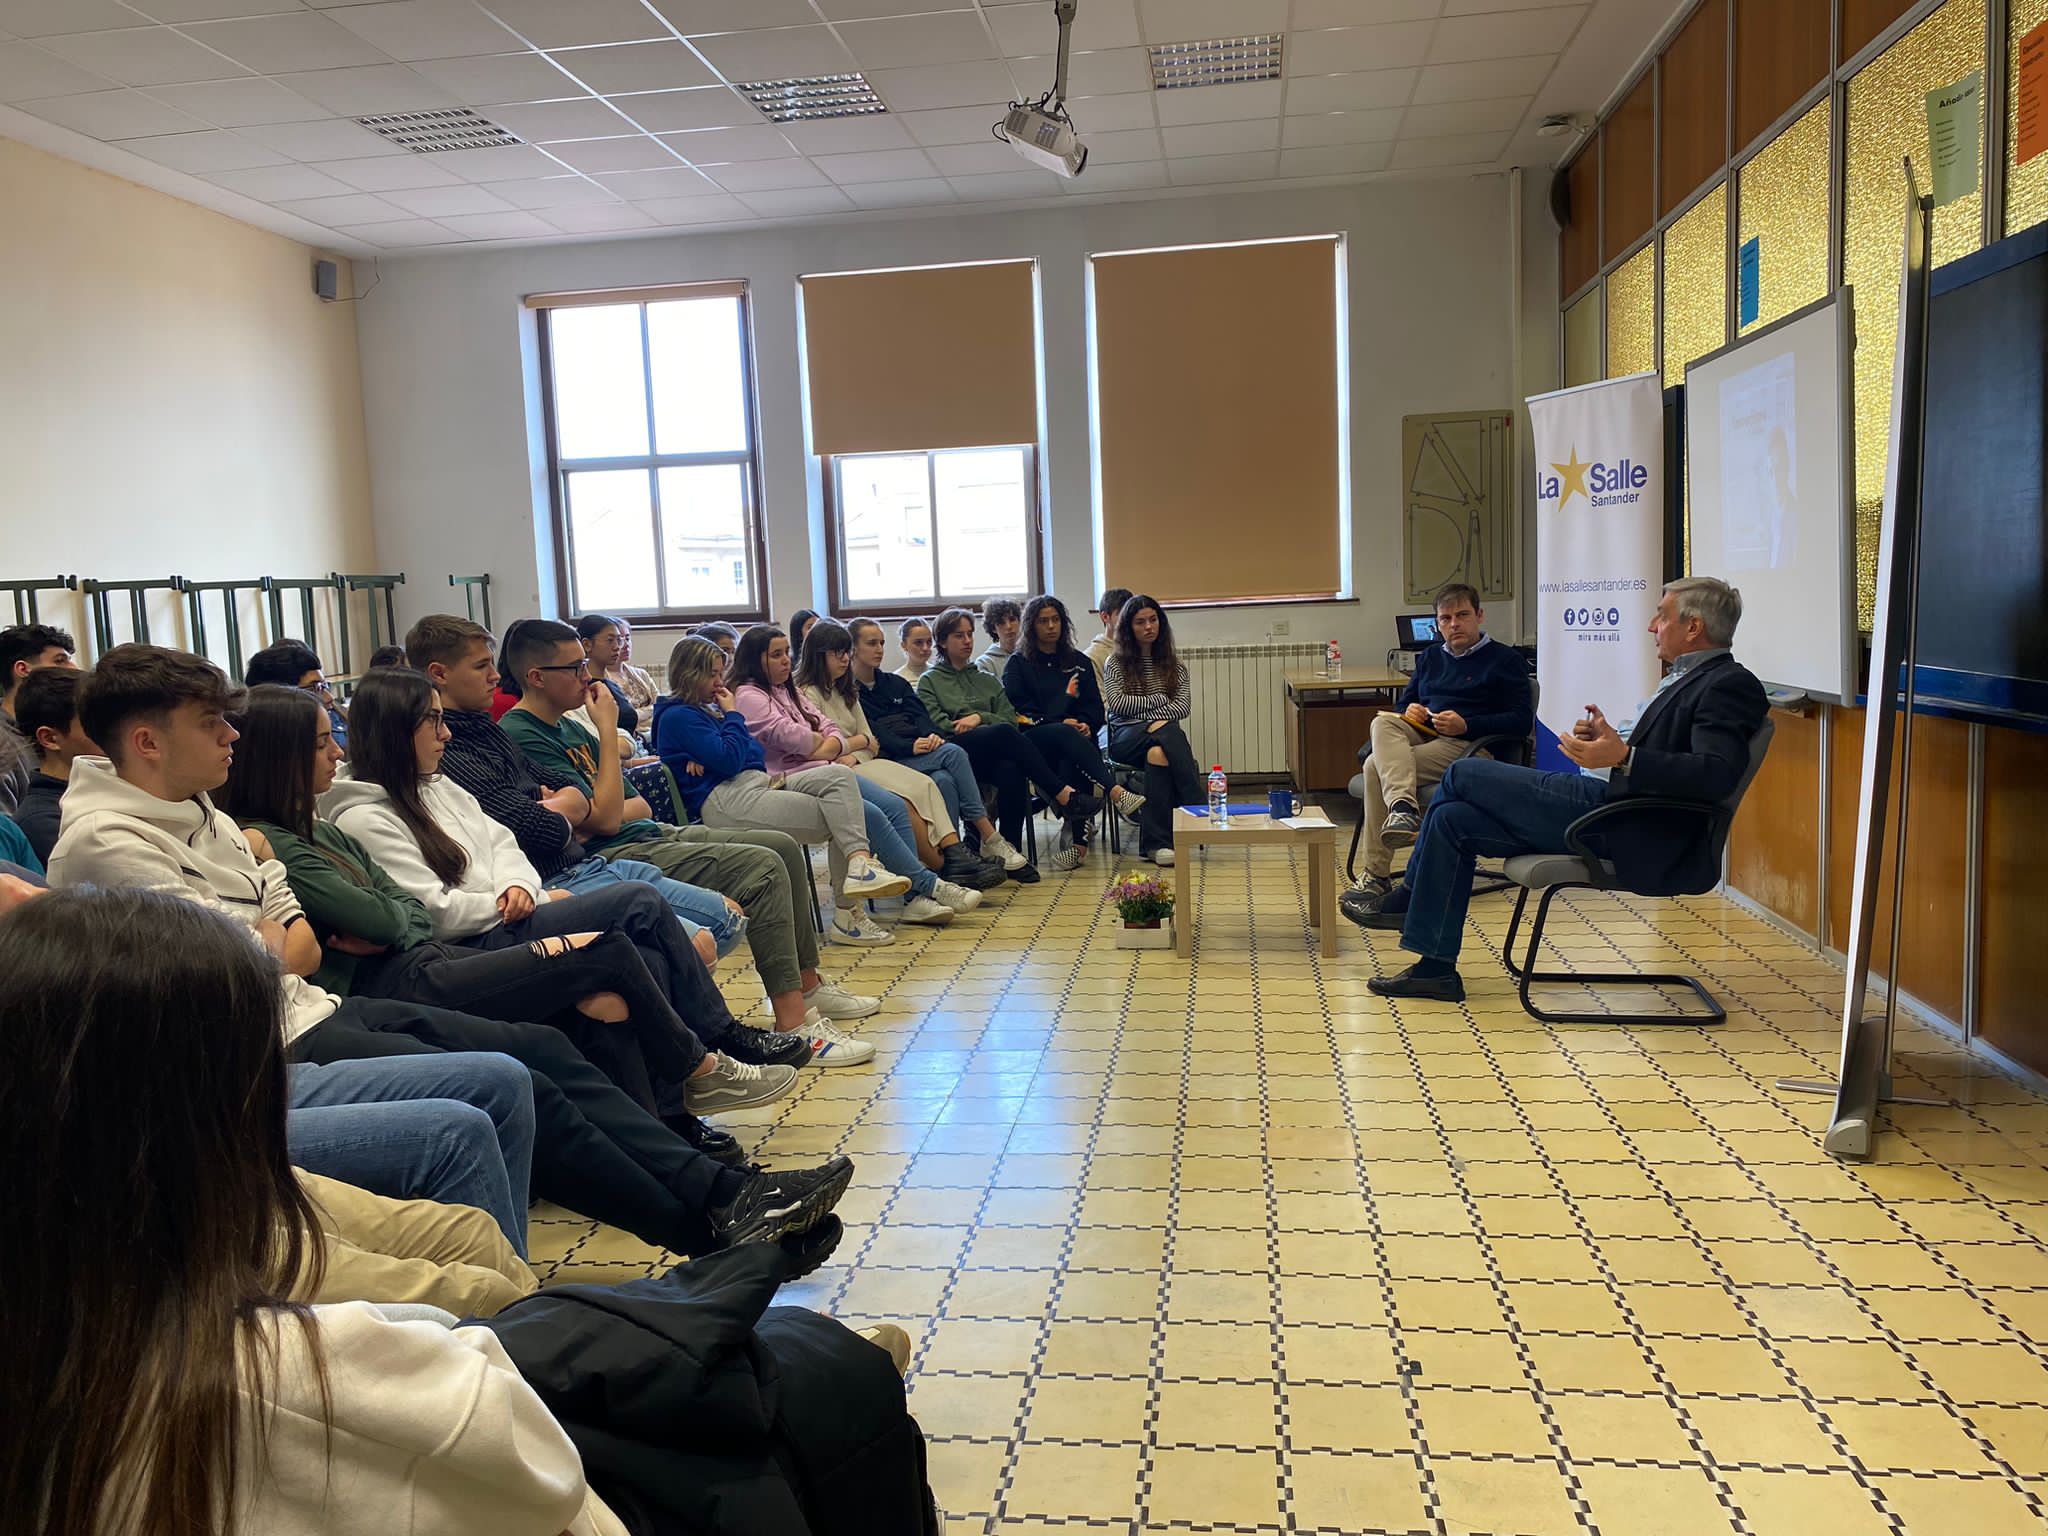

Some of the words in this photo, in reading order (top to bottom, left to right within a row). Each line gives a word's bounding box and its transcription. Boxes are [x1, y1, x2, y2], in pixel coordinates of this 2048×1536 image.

[1538, 472, 1559, 499] La
[1590, 459, 1648, 493] Salle
[1591, 492, 1640, 507] Santander
[1539, 578, 1647, 593] www.lasallesantander.es
